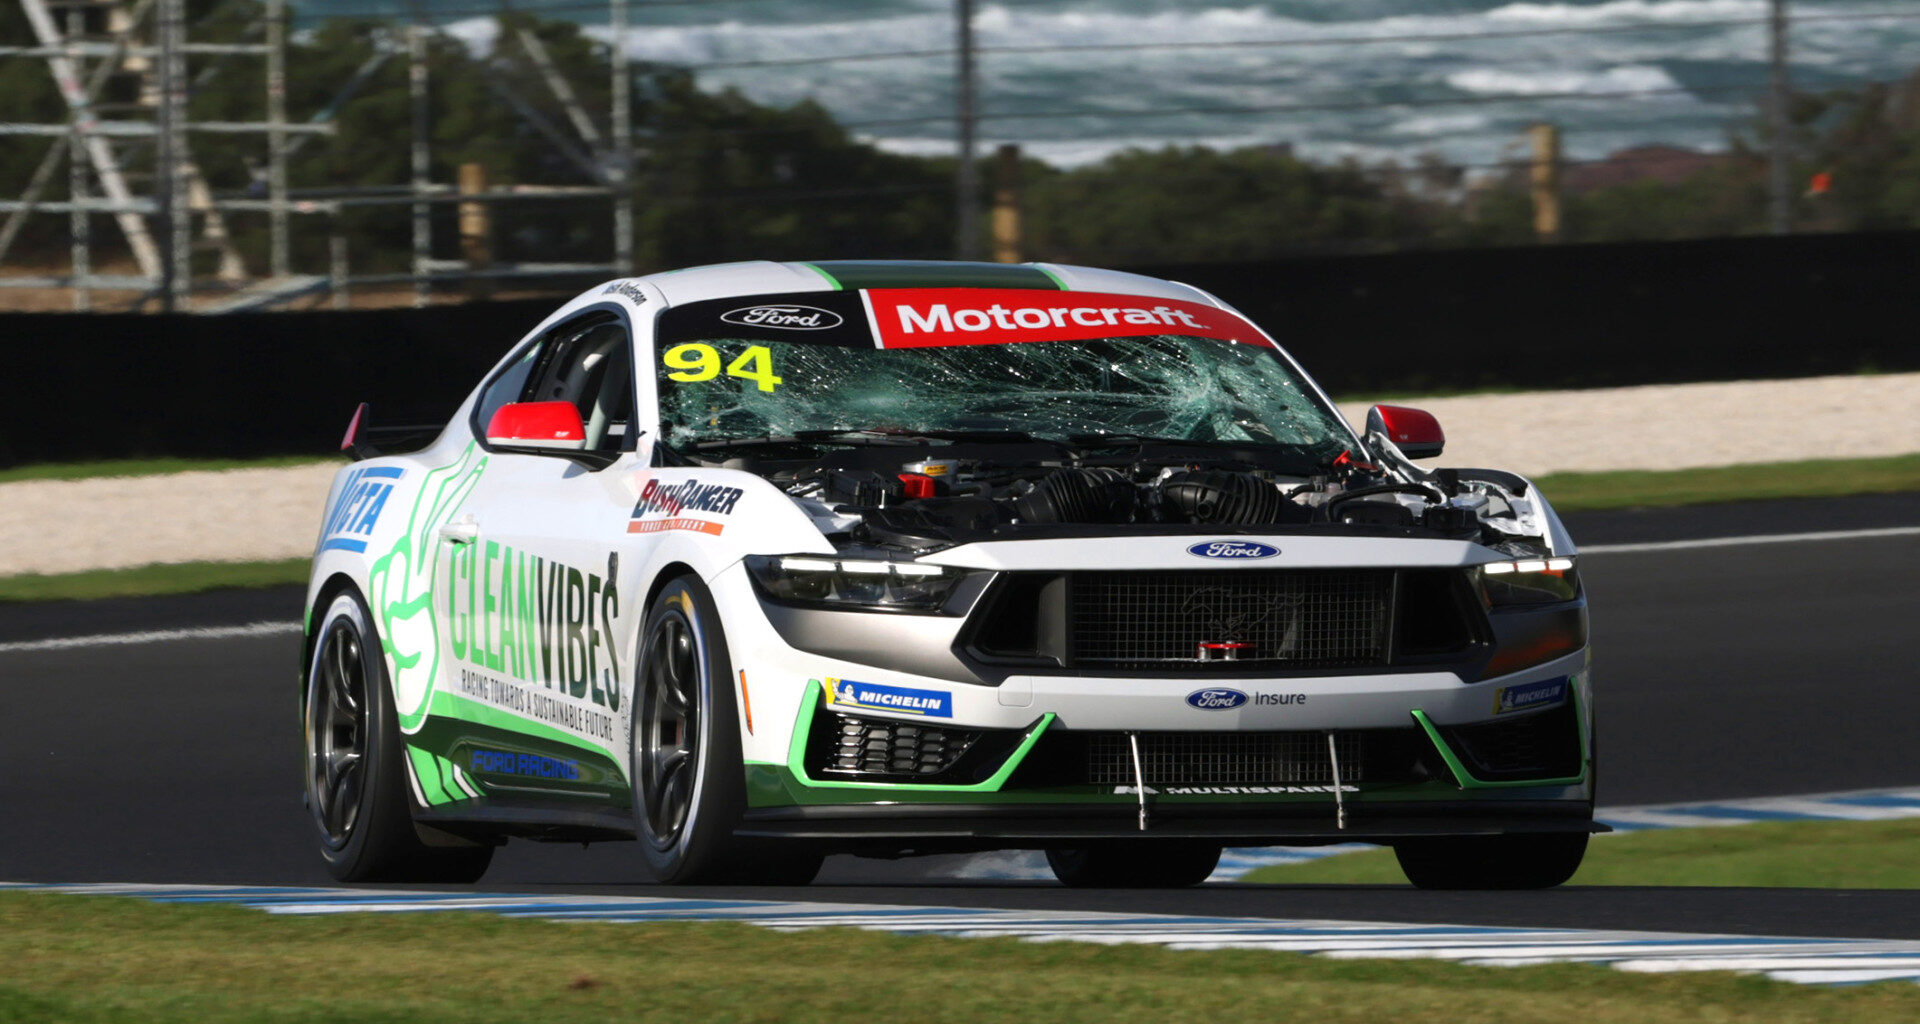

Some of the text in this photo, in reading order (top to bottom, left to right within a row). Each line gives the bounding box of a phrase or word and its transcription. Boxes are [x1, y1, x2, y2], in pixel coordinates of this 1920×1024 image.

[743, 307, 821, 327] Ford
[896, 303, 1204, 334] Motorcraft
[663, 343, 783, 393] 94
[318, 469, 395, 554] VICTA
[1206, 542, 1262, 557] Ford
[462, 668, 489, 700] RACING
[490, 678, 524, 713] TOWARDS
[527, 691, 532, 715] A
[533, 693, 584, 732] SUSTAINABLE
[585, 709, 613, 742] FUTURE
[860, 691, 942, 710] MICHELIN
[1197, 691, 1306, 707] Ford Insure
[1515, 684, 1562, 706] MICHELIN
[472, 750, 580, 780] FORD RACING
[1166, 785, 1360, 794] MULTISPARES
